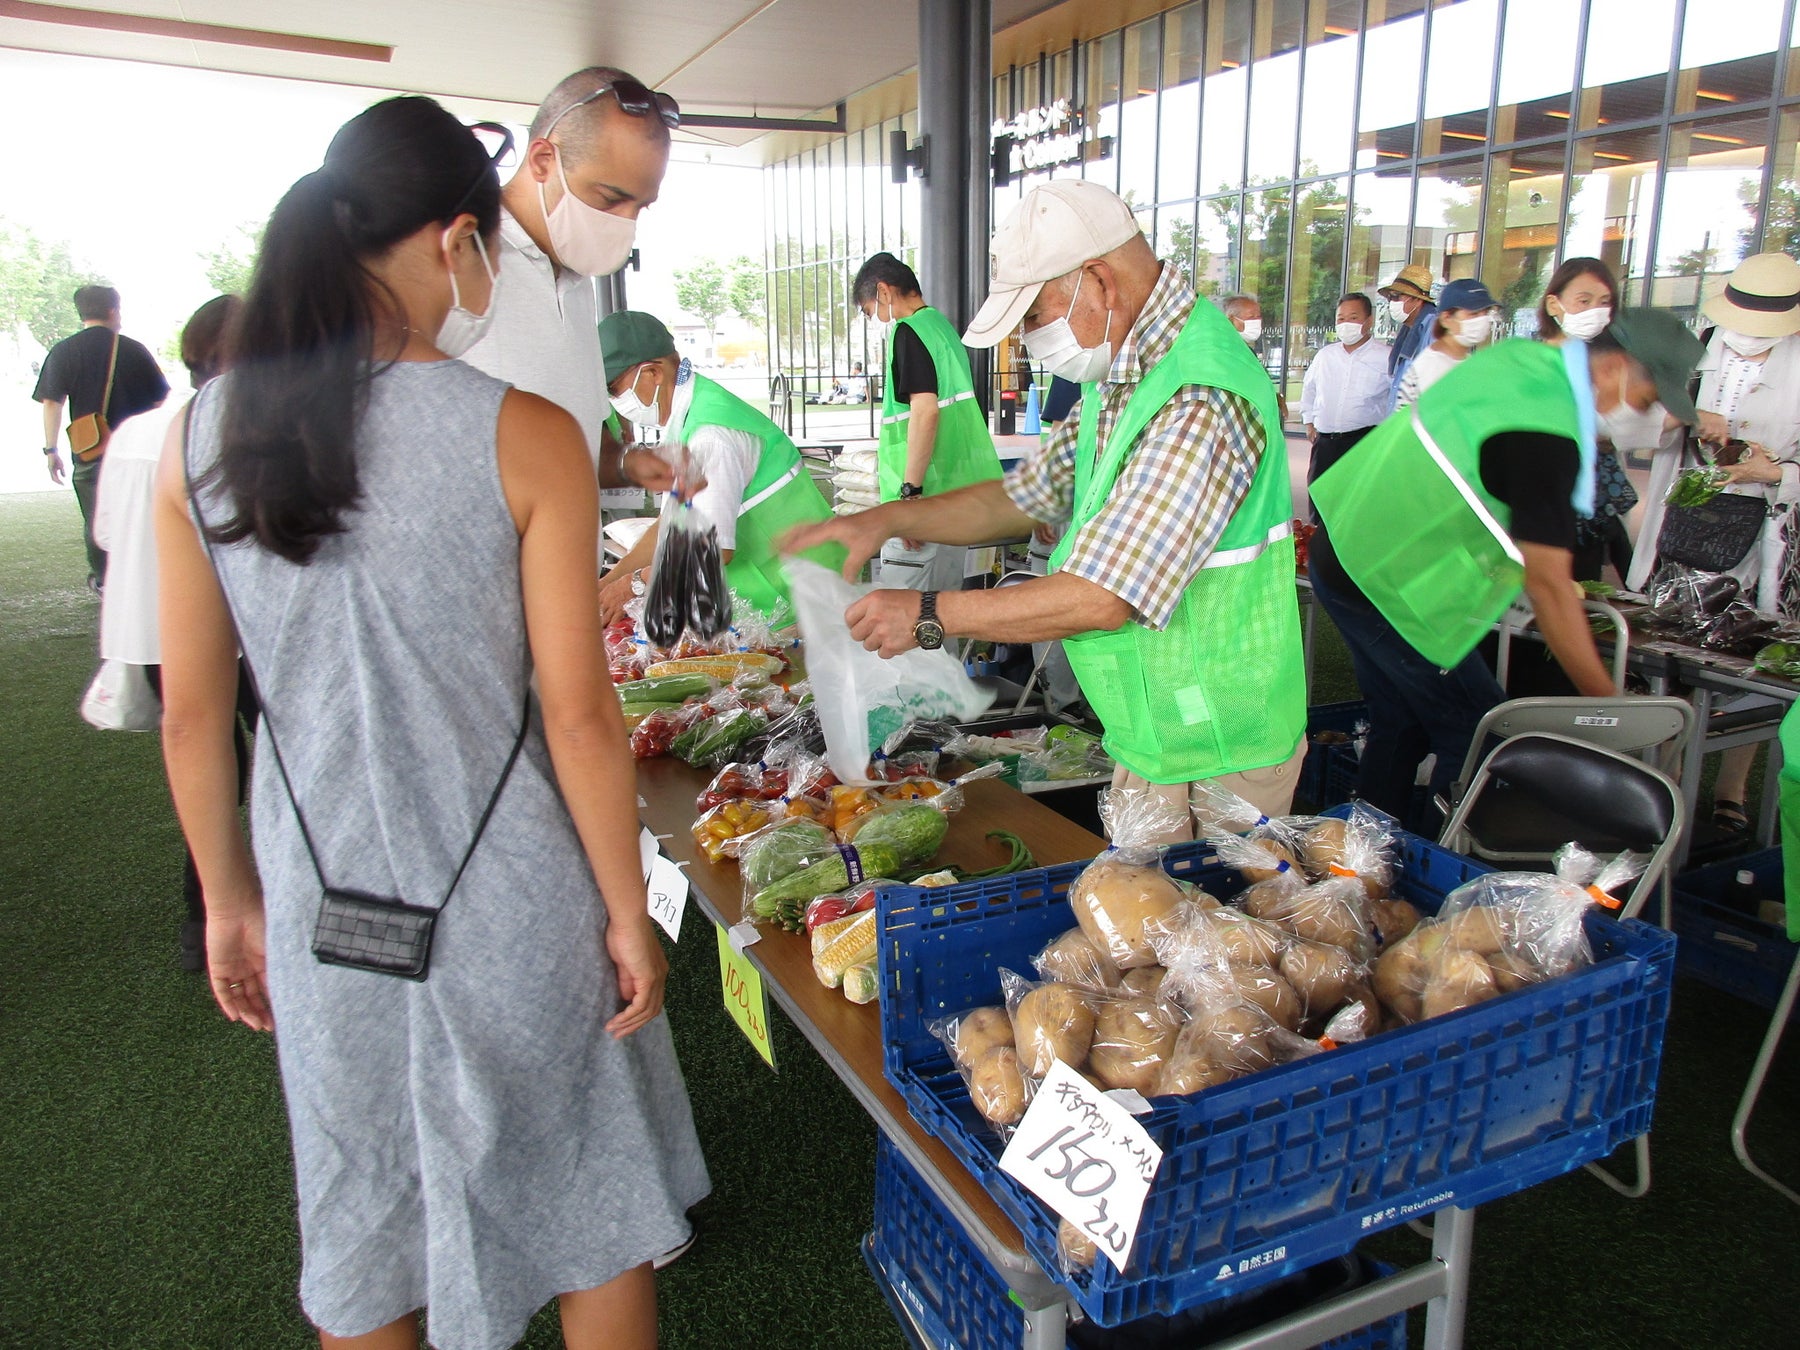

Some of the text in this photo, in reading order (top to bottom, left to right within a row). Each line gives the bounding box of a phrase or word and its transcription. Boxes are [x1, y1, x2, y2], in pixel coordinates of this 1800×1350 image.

[1400, 1190, 1454, 1215] Returnable
[1238, 1246, 1286, 1274] 自然王国
